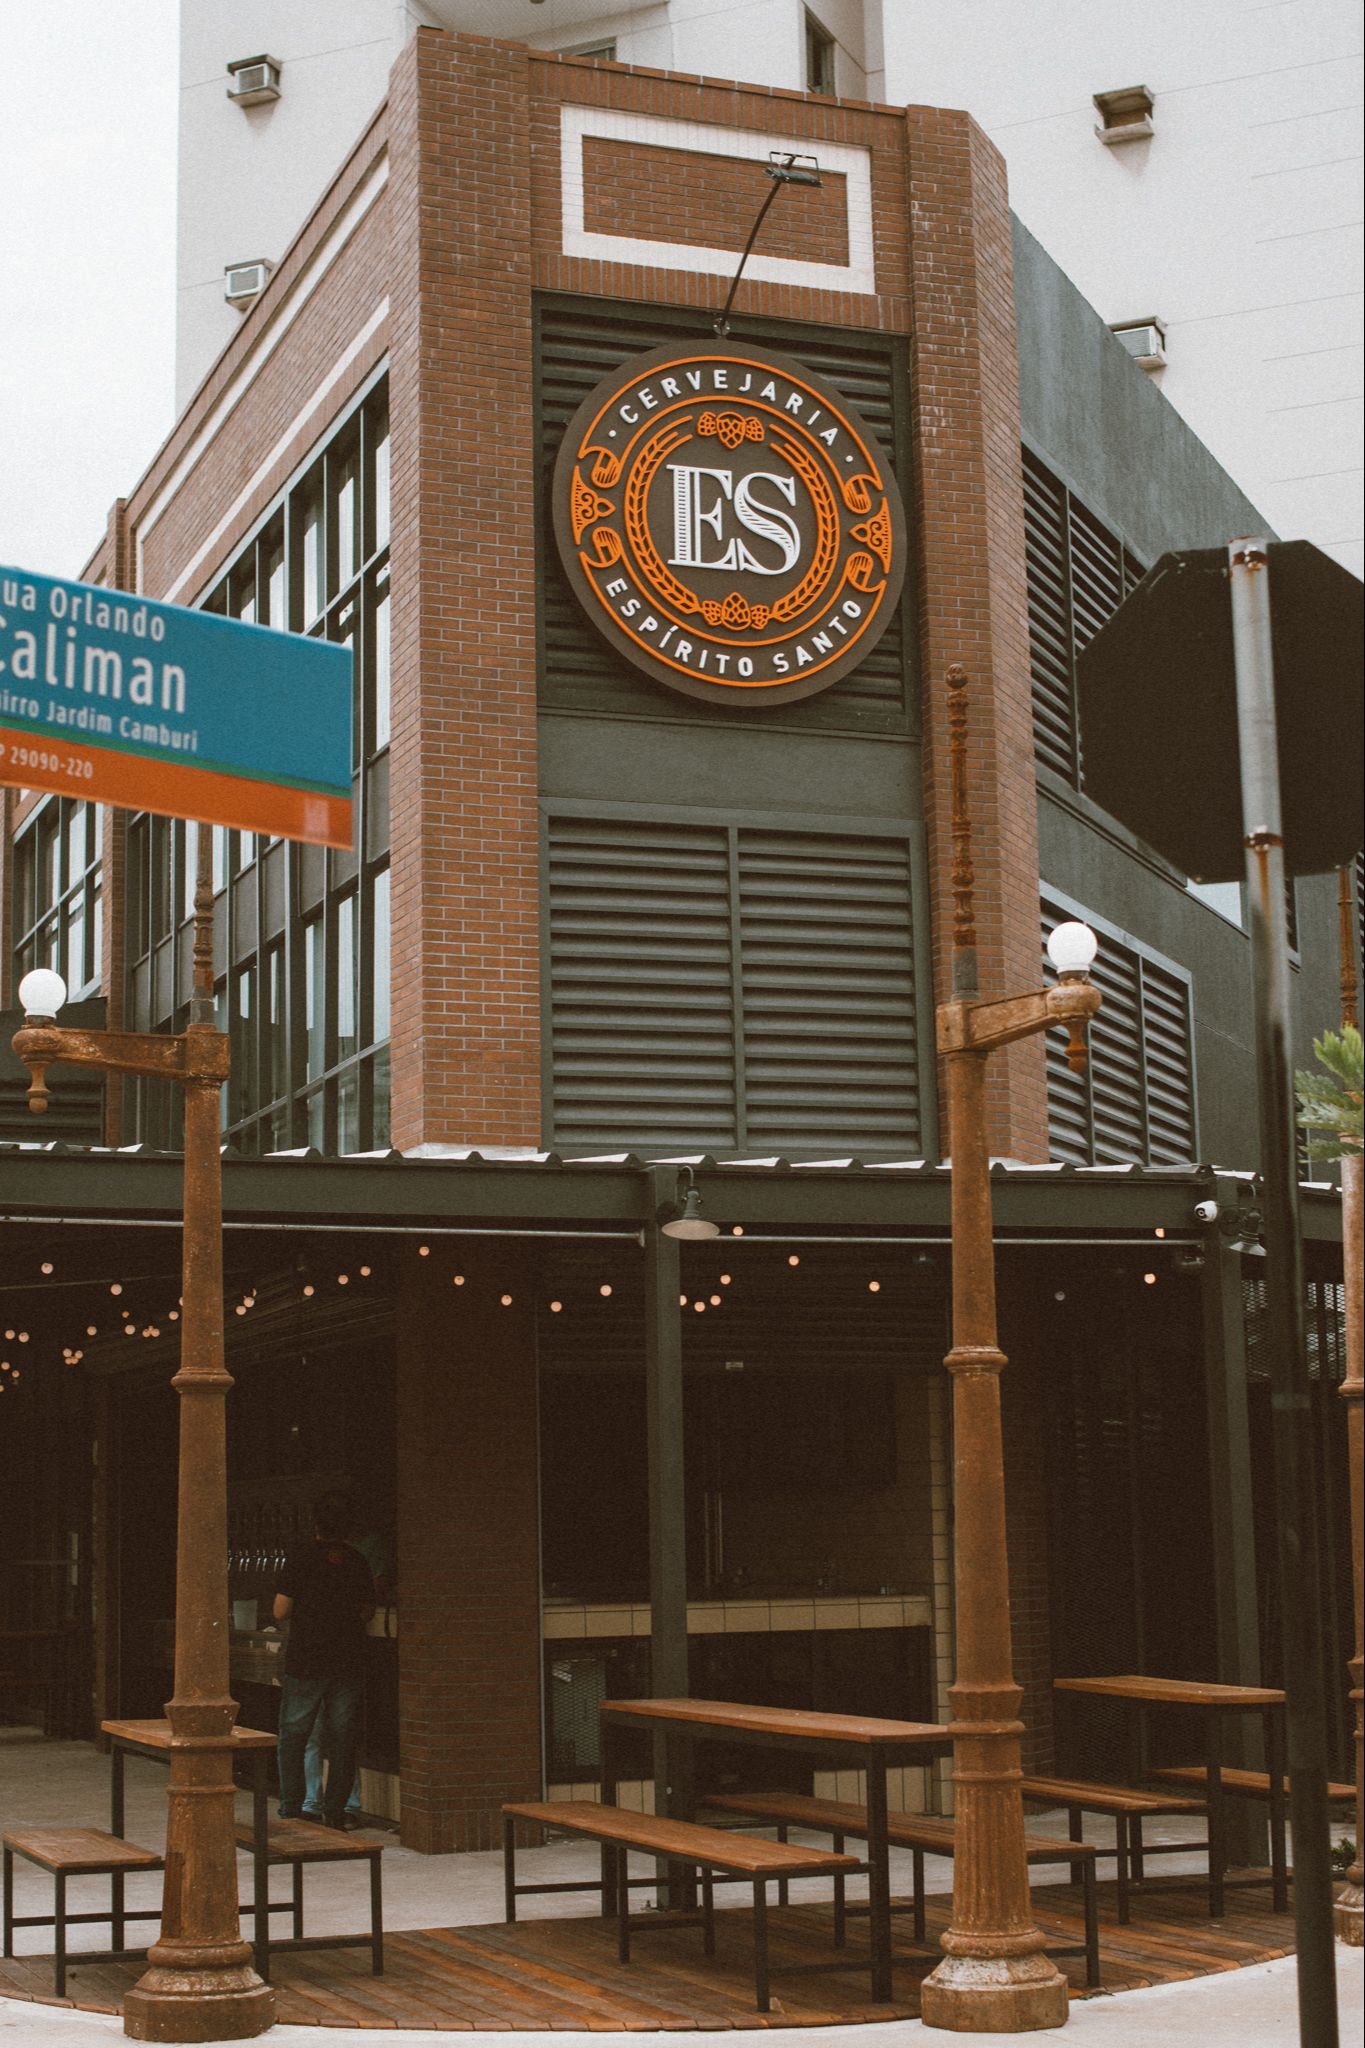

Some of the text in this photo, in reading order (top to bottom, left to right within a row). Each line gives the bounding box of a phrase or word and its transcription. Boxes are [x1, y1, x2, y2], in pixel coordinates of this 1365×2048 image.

[619, 369, 839, 447] CERVEJARIA
[666, 464, 801, 575] ES
[50, 586, 165, 642] Orlando
[605, 577, 862, 677] ESPÍRITO SANTO
[0, 613, 187, 713] aliman
[0, 689, 198, 752] irro Jardim Camburi
[10, 745, 94, 779] 29090-220
